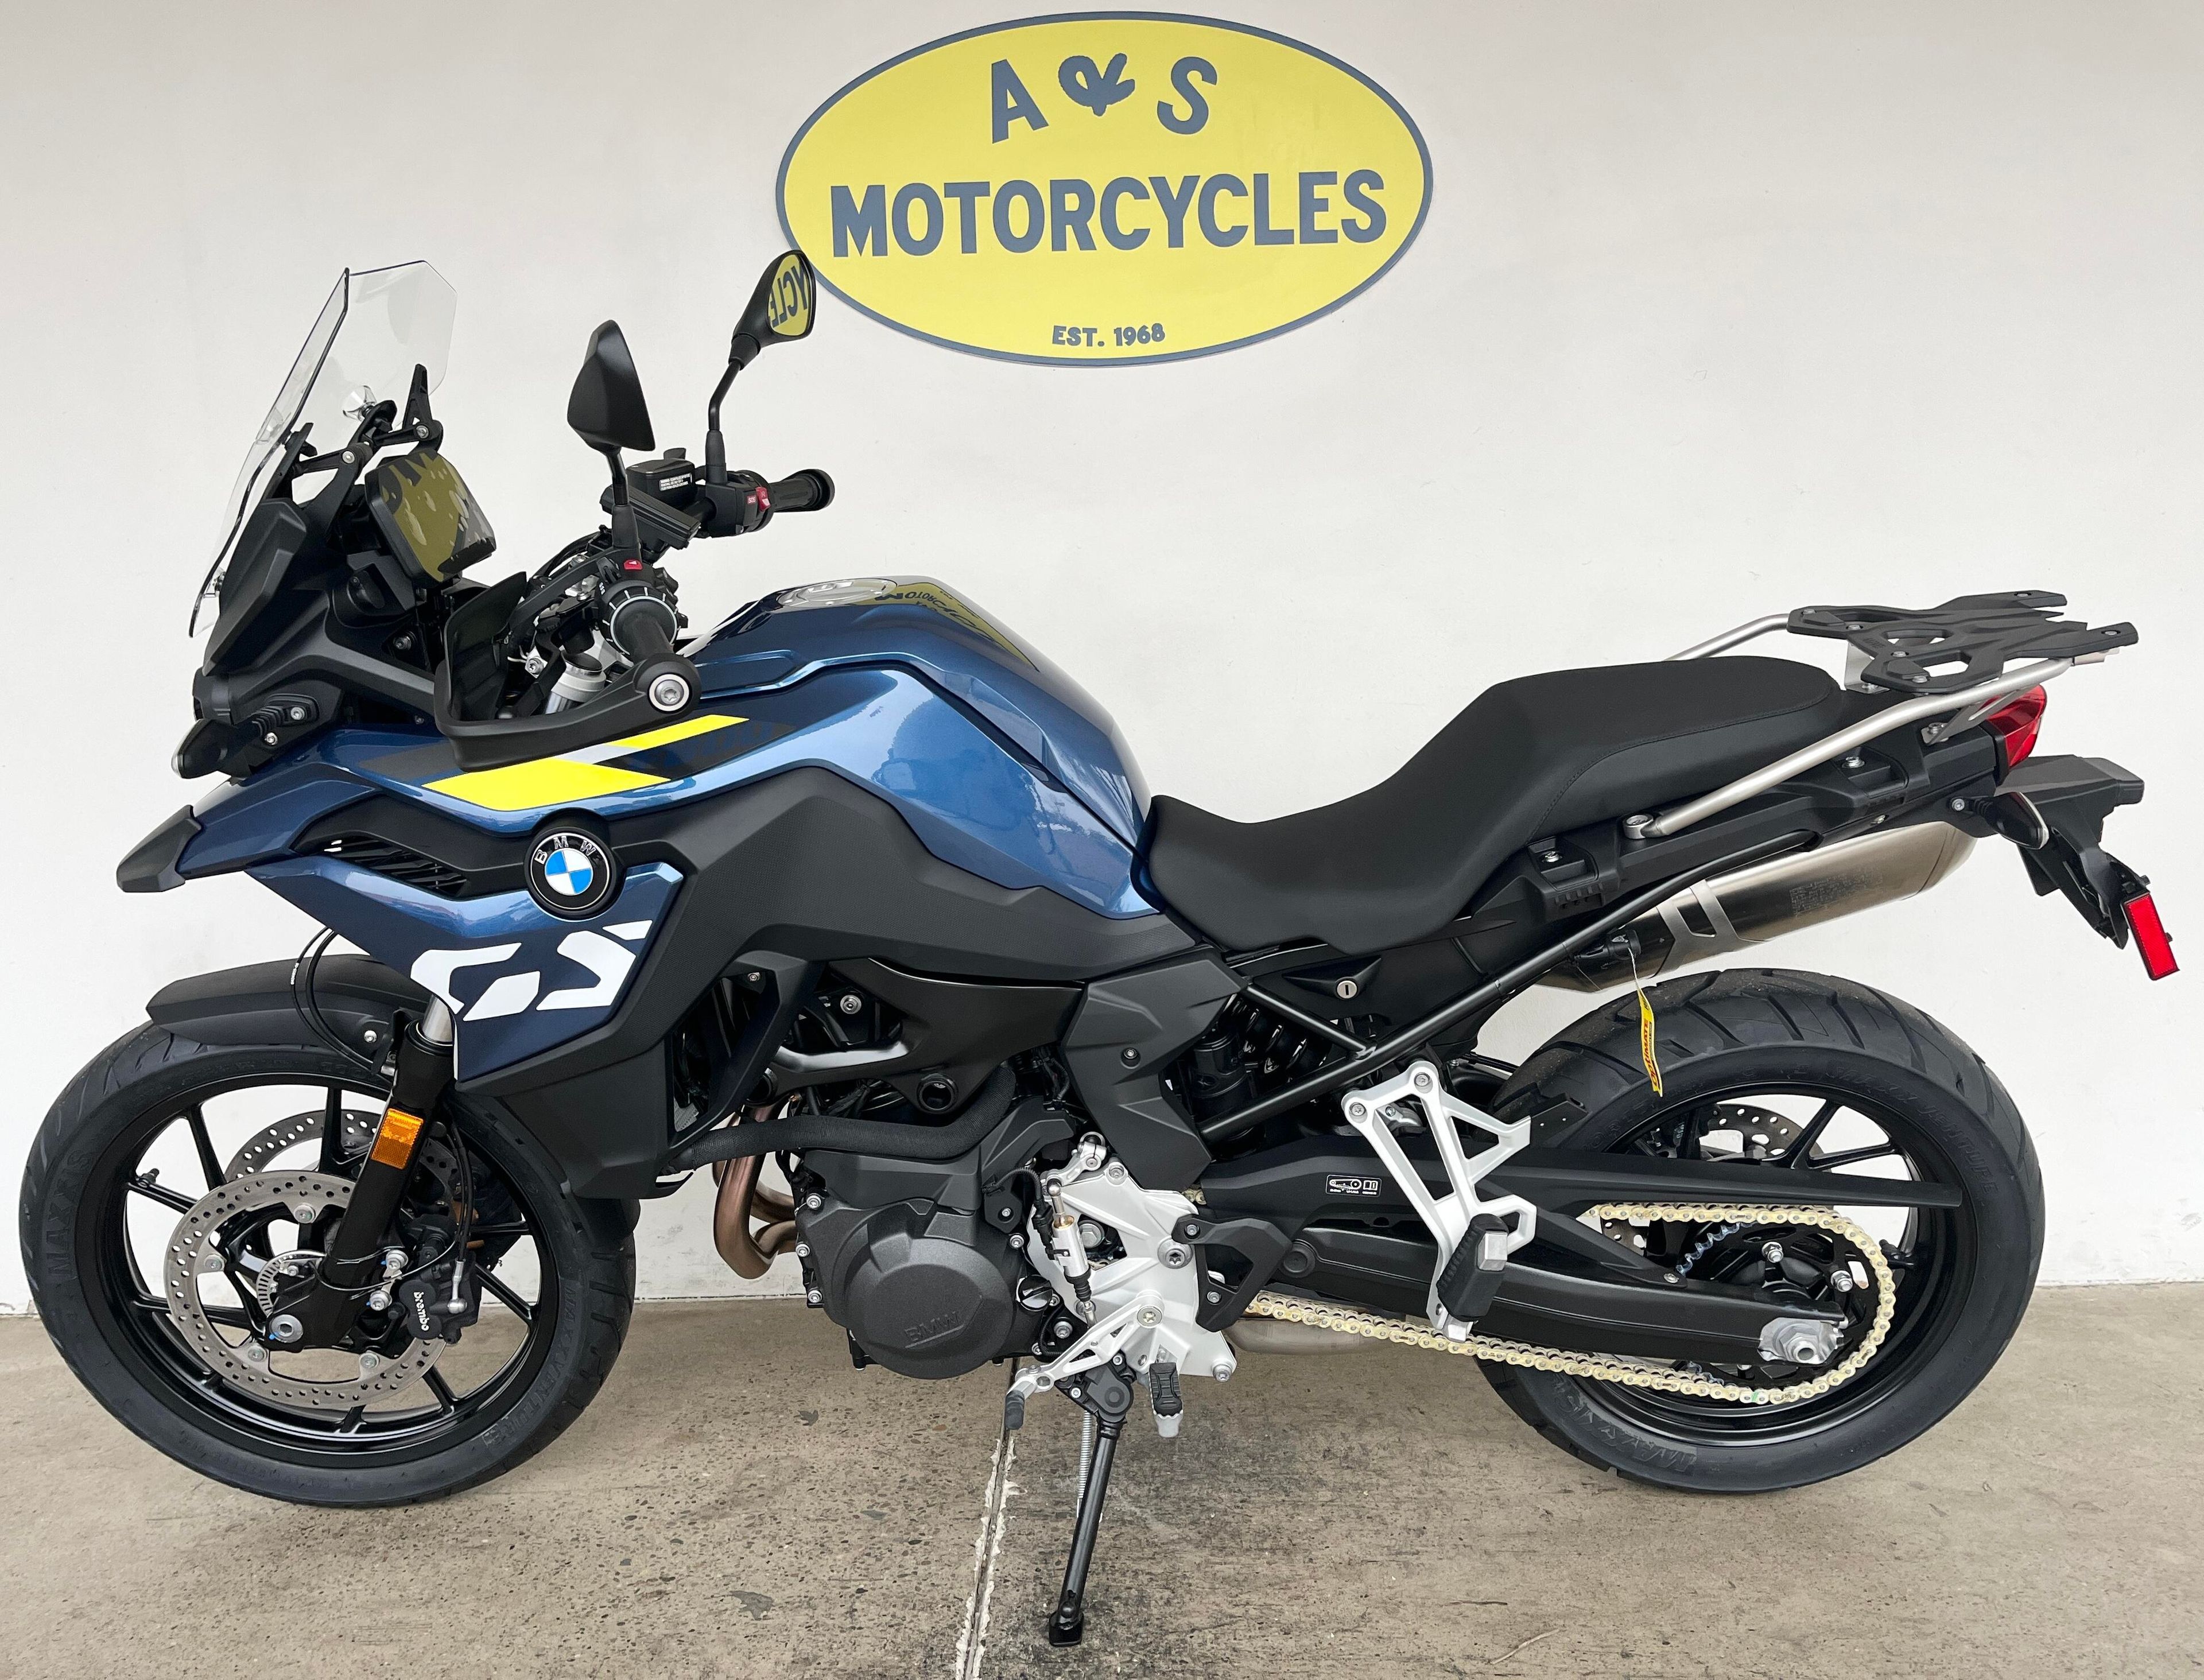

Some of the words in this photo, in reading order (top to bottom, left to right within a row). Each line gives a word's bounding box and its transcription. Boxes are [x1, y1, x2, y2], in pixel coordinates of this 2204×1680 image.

[992, 60, 1048, 143] A
[1157, 56, 1217, 135] S
[831, 170, 1387, 257] MOTORCYCLES
[1053, 325, 1105, 346] EST.
[1114, 323, 1166, 346] 1968
[534, 835, 596, 864] BMW
[413, 1291, 430, 1331] brembo
[905, 1310, 959, 1341] BMW
